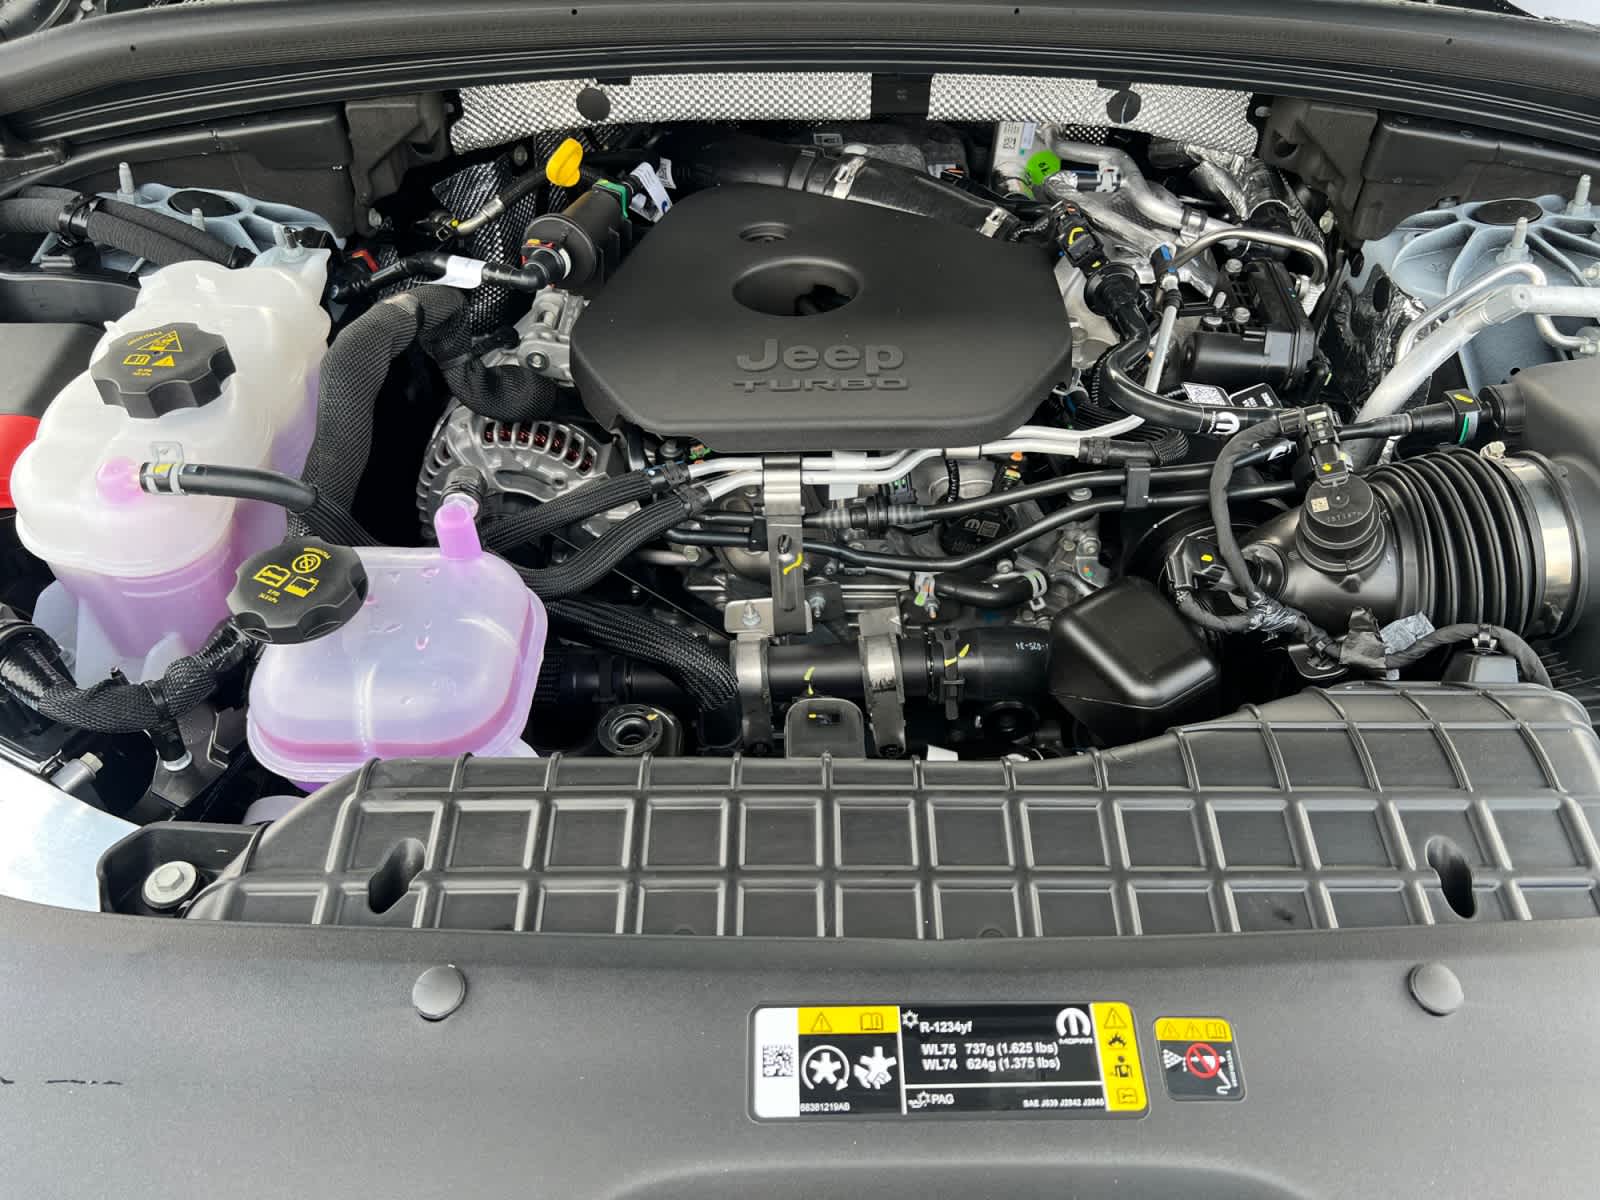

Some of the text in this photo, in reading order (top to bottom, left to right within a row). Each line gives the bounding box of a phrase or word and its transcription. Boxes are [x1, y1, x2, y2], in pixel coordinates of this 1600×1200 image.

[736, 339, 905, 377] Jeep
[733, 377, 910, 394] TURBO
[919, 1020, 973, 1036] R-1234yf
[920, 1041, 1059, 1057] WL75 737g (1.625 lbs)
[922, 1056, 1061, 1072] WL74 624g (1.375 lbs)
[931, 1093, 955, 1105] PAG
